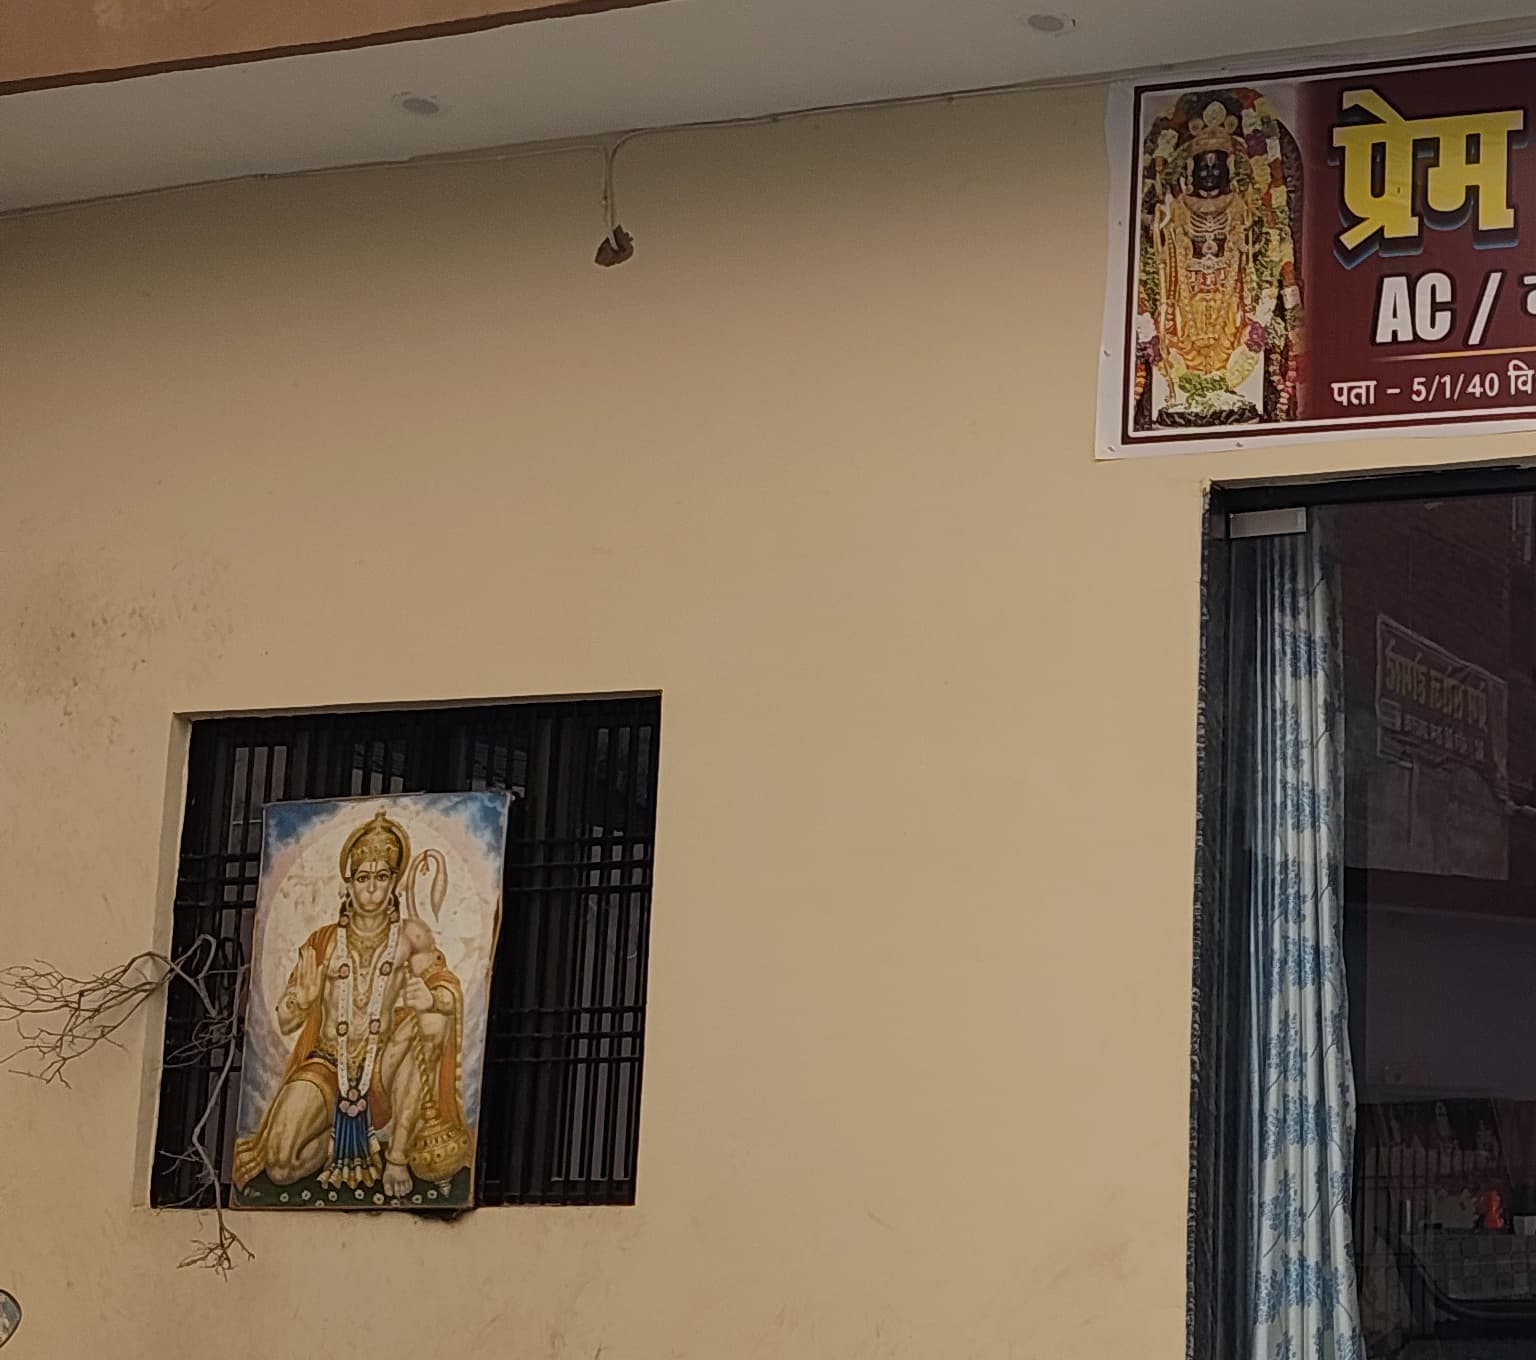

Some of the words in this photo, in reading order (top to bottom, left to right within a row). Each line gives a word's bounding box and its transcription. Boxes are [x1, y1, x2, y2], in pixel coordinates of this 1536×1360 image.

[1333, 89, 1523, 250] प्रेम
[1375, 273, 1453, 344] AC
[1331, 380, 1376, 406] पता
[1411, 372, 1499, 402] 5/1/40
